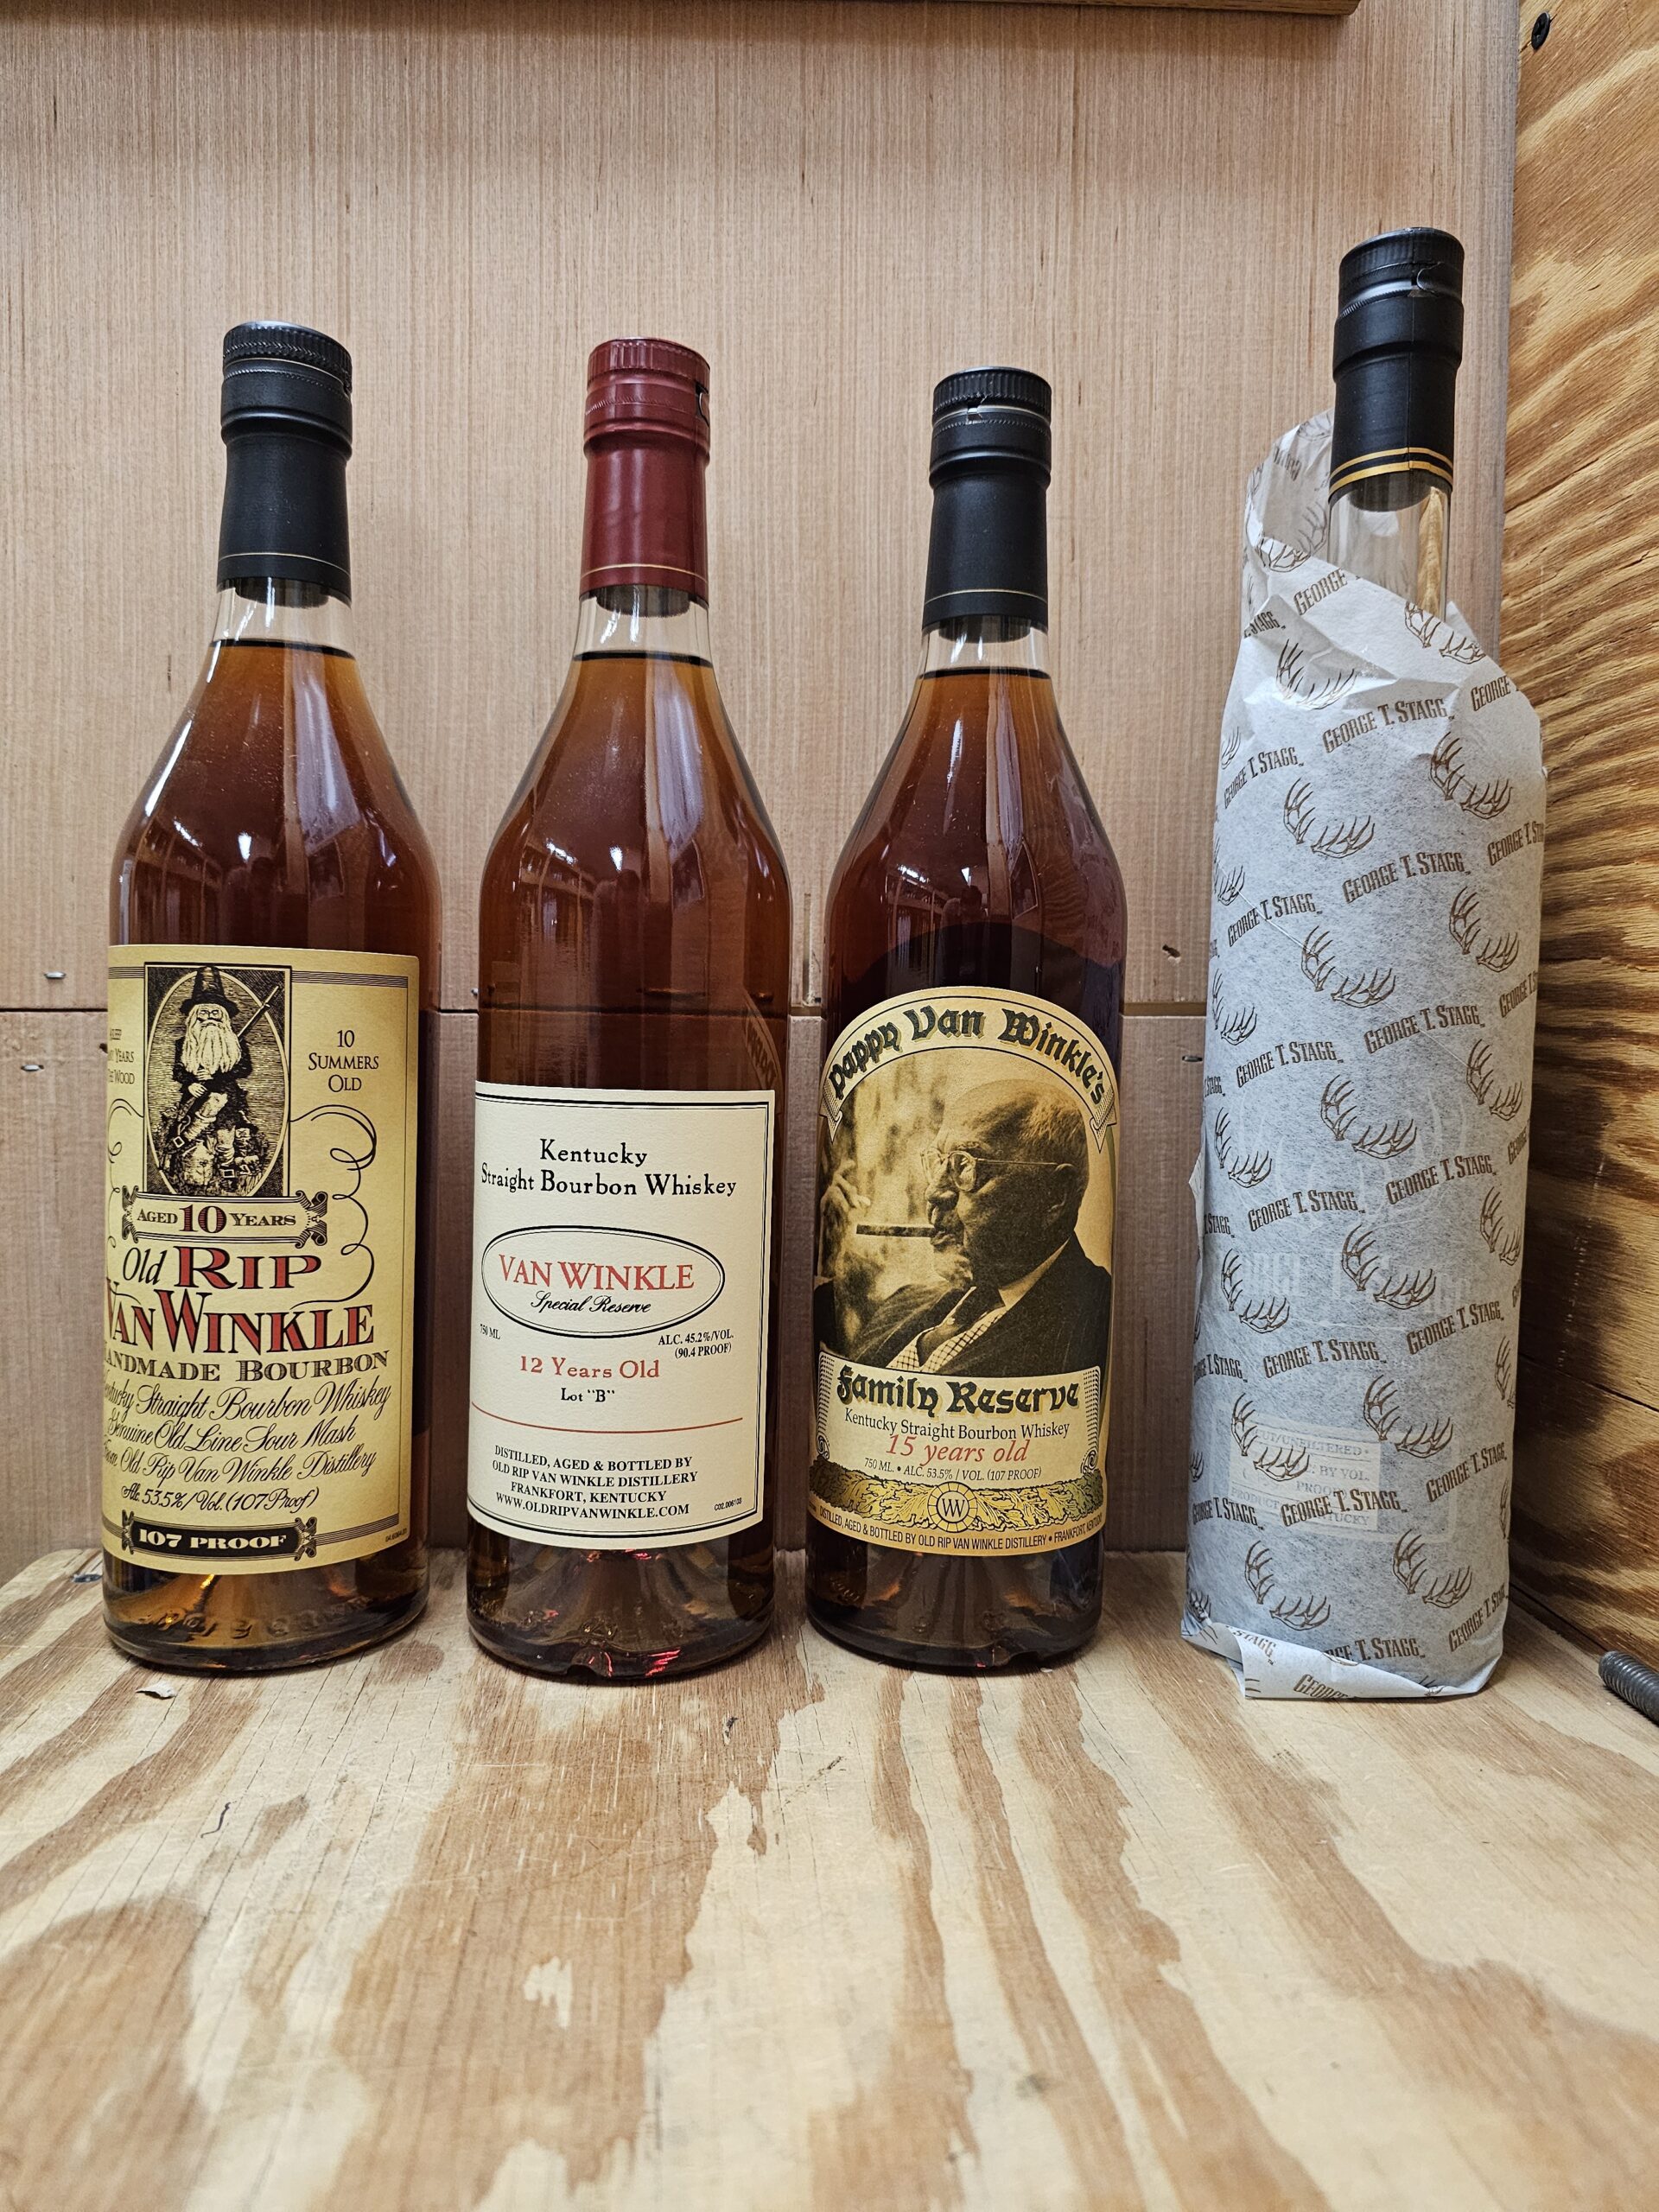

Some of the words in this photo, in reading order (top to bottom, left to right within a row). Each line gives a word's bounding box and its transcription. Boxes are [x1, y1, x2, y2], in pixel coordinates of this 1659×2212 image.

[1294, 568, 1348, 616] GEORGE
[1471, 676, 1511, 711] GEORGE
[1322, 712, 1377, 753] GEORGE
[1395, 698, 1447, 722] STAGG
[1224, 766, 1248, 809] GEORGE
[1257, 747, 1298, 774] STAGG
[1488, 829, 1523, 866] GEORGE
[1342, 862, 1399, 904] GEORGE
[1416, 852, 1465, 875] STAGG
[1228, 907, 1260, 947] GEORGE
[1272, 893, 1316, 918] STAGG
[337, 1029, 354, 1048] 10
[1364, 1014, 1420, 1054] GEORGE
[1435, 1005, 1480, 1028] STAGG
[308, 1052, 378, 1071] SUMMERS
[828, 1021, 903, 1101] Pappy
[902, 1005, 987, 1043] Van
[997, 1007, 1105, 1105] Winkle's
[1236, 1051, 1274, 1088] GEORGE
[1288, 1041, 1338, 1064] STAGG
[114, 1070, 135, 1084] WOOD
[328, 1074, 362, 1092] OLD
[539, 1138, 647, 1167] Kentucky
[480, 1162, 535, 1192] Straight
[540, 1169, 637, 1195] Bourbon
[645, 1173, 737, 1197] Whiskey
[1386, 1166, 1440, 1205] GEORGE
[1454, 1154, 1493, 1178] STAGG
[137, 1209, 178, 1224] AGED
[179, 1205, 227, 1233] 10
[231, 1212, 296, 1226] YEARS
[1208, 1213, 1230, 1235] STAGG
[1248, 1198, 1293, 1231] GEORGE
[1307, 1190, 1358, 1211] STAGG
[123, 1247, 168, 1286] Old
[173, 1246, 321, 1290] RIP
[499, 1254, 553, 1287] VAN
[557, 1261, 695, 1291] WINKLE
[531, 1290, 593, 1313] Special
[589, 1294, 652, 1313] Reserve
[154, 1288, 374, 1356] WINKLE
[488, 1326, 501, 1340] ML
[658, 1333, 683, 1345] ALC.
[684, 1329, 734, 1344] 45.2%/VOL.
[1406, 1315, 1456, 1355] GEORGE
[1469, 1300, 1501, 1325] STAGG
[105, 1348, 220, 1382] ANDMADE
[235, 1350, 390, 1382] BOURBON
[520, 1355, 543, 1374] 12
[550, 1357, 613, 1379] Years
[619, 1359, 660, 1379] Old
[674, 1347, 696, 1359] (90.4
[697, 1342, 733, 1357] PROOF)
[1213, 1354, 1243, 1379] STAGG
[1263, 1345, 1313, 1379] GEORGE
[1327, 1338, 1380, 1362] STAGG
[136, 1383, 210, 1426] Straight
[209, 1386, 312, 1420] Bourbon
[314, 1375, 391, 1420] Whiskey
[561, 1387, 583, 1402] Lot
[836, 1363, 940, 1417] Family
[945, 1381, 1080, 1414] Reserve
[108, 1408, 154, 1445] Genuine
[155, 1420, 193, 1449] Old
[184, 1424, 242, 1452] Line
[244, 1426, 297, 1452] Sour
[302, 1415, 356, 1448] Mash
[845, 1408, 898, 1434] Kentucky
[900, 1419, 955, 1441] Straight
[958, 1425, 1016, 1440] Bourbon
[1020, 1422, 1070, 1439] Whiskey
[120, 1446, 145, 1474] Old
[143, 1452, 175, 1488] Rip
[179, 1456, 219, 1483] Van
[222, 1454, 292, 1483] Winkle
[298, 1444, 377, 1479] Distillery
[495, 1445, 550, 1468] DISTILLED,
[553, 1458, 590, 1471] AGED
[593, 1460, 604, 1471] &
[607, 1458, 672, 1471] BOTTLED
[675, 1456, 693, 1469] BY
[886, 1433, 917, 1456] 15
[919, 1441, 984, 1465] years
[994, 1439, 1031, 1462] old
[492, 1459, 511, 1475] OLD
[512, 1465, 530, 1478] RIP
[531, 1470, 557, 1484] VAN
[560, 1474, 614, 1487] WINKLE
[618, 1471, 698, 1487] DISTILLERY
[864, 1458, 876, 1468] 750
[904, 1465, 925, 1477] ALC.
[962, 1470, 984, 1480] VOL.
[987, 1469, 1005, 1481] (107
[1007, 1466, 1041, 1480] PROOF)
[1426, 1460, 1471, 1503] GEORGE
[495, 1491, 690, 1519] WWW.OLDRIPVANWINKLE.COM
[511, 1481, 587, 1504] FRANKFORT,
[589, 1491, 668, 1503] KENTUCKY
[1281, 1496, 1332, 1527] GEORGE
[1350, 1489, 1401, 1510] STAGG
[1222, 1497, 1257, 1526] STAGG
[139, 1529, 183, 1548] 107
[189, 1535, 287, 1549] PROOF
[844, 1520, 861, 1532] AGED
[863, 1525, 868, 1535] &
[870, 1527, 902, 1541] BOTTLED
[906, 1533, 916, 1544] BY
[918, 1535, 935, 1546] OLD
[938, 1538, 950, 1548] RIP
[953, 1538, 969, 1549] VAN
[972, 1538, 1002, 1549] WINKLE
[1005, 1535, 1046, 1548] DISTILLERY
[1449, 1607, 1484, 1652] GEORGE
[1370, 1637, 1420, 1659] STAGG
